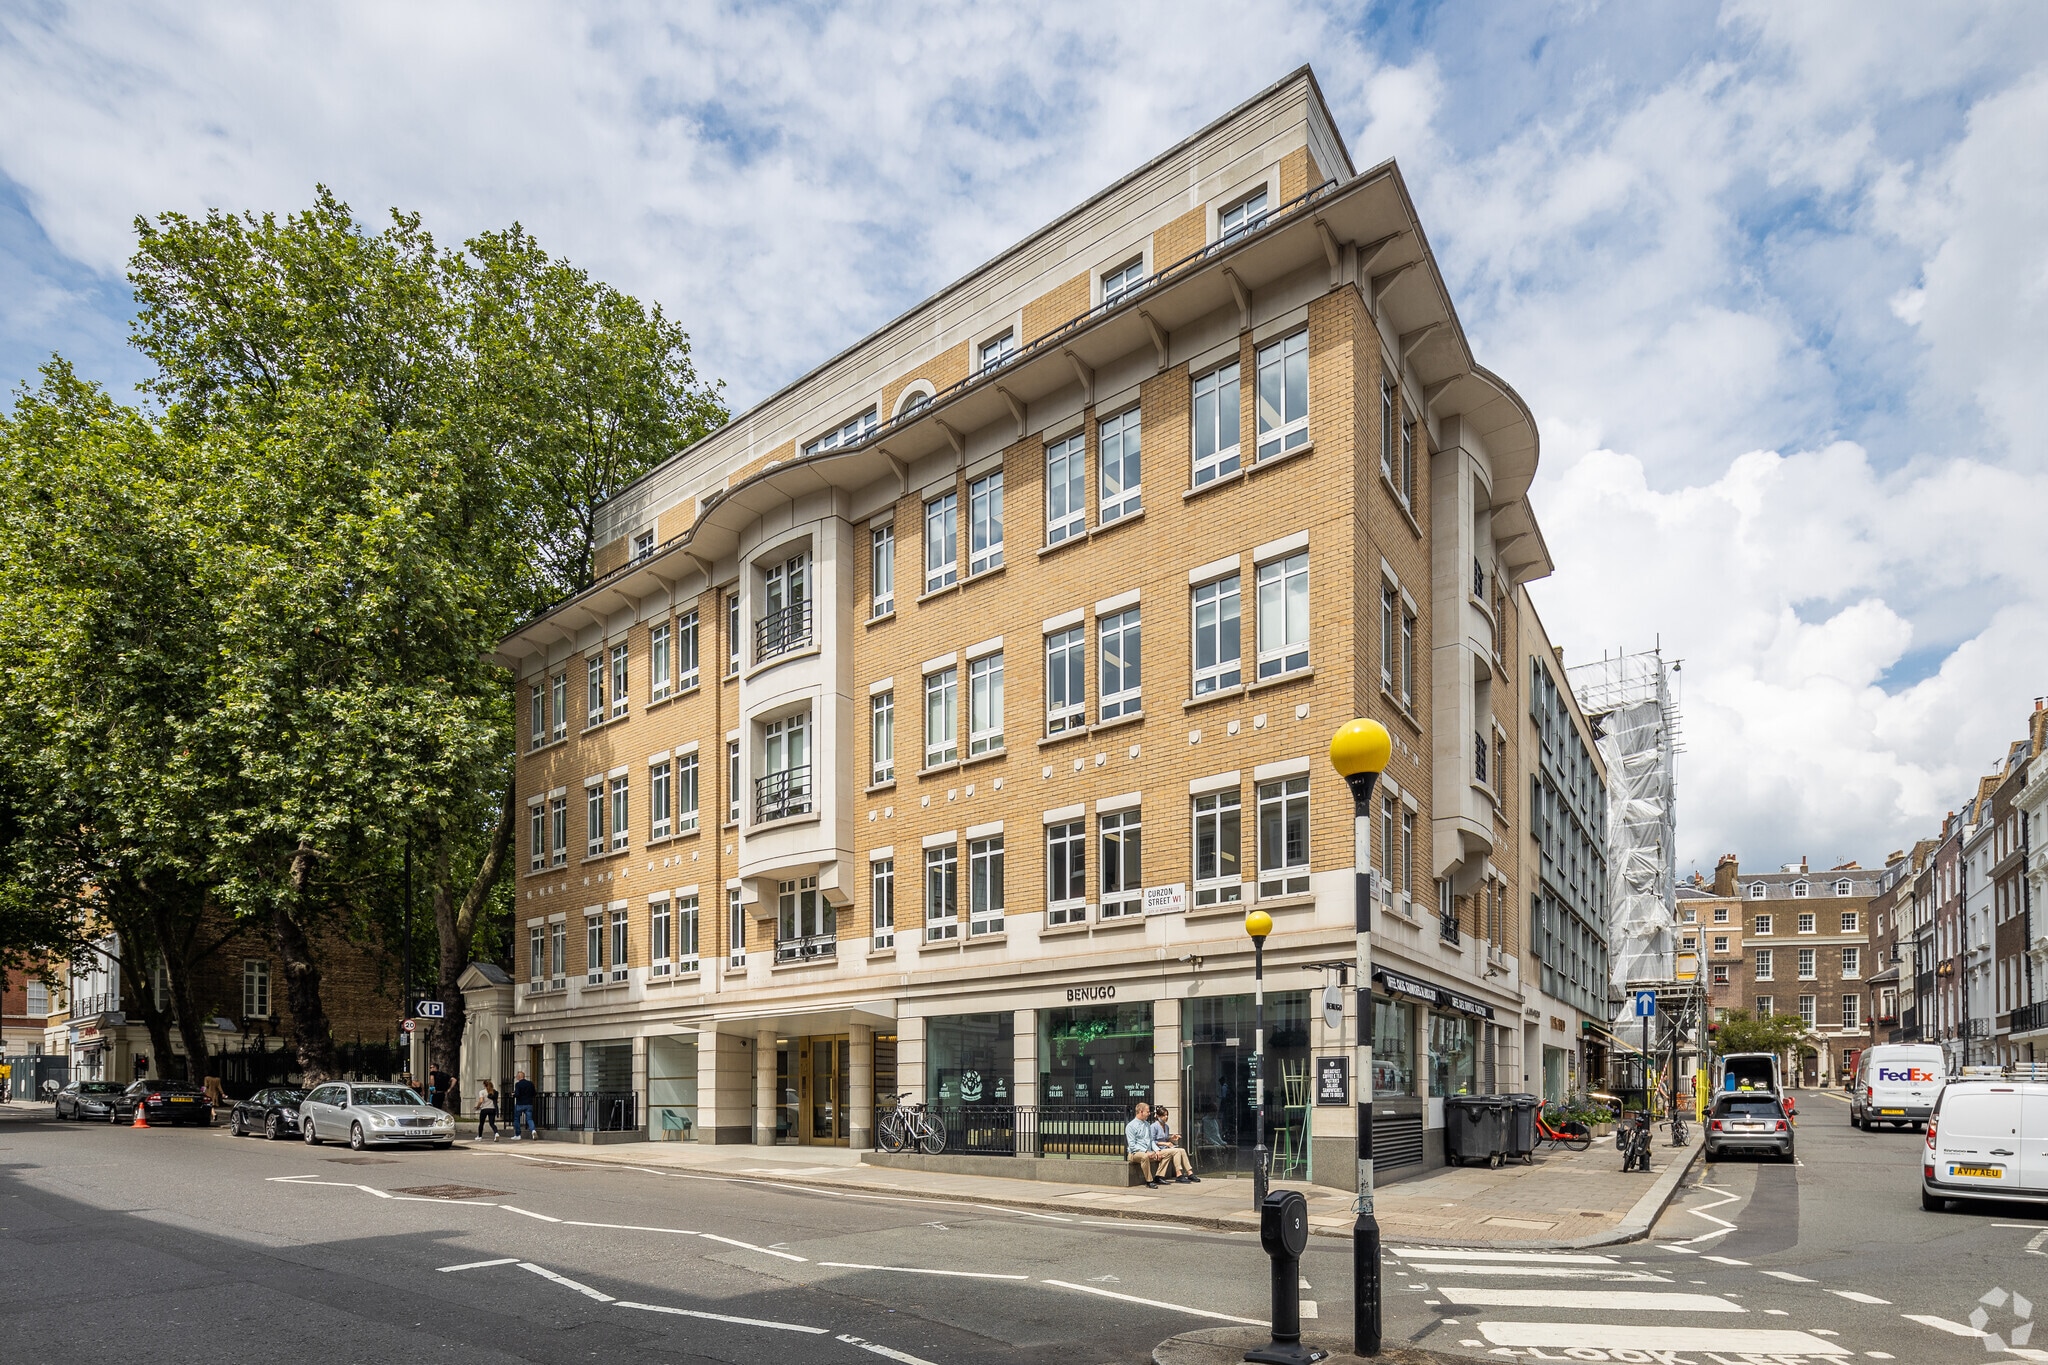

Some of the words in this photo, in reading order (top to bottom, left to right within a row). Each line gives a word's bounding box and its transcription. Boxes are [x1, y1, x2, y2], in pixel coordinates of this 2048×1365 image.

[1148, 888, 1173, 898] CURZON
[1148, 897, 1170, 907] STREET
[1172, 895, 1181, 903] W1
[1067, 986, 1115, 1001] BENUGO
[432, 1004, 440, 1014] P
[1879, 1068, 1934, 1081] FedEx
[1979, 1169, 1998, 1177] AEU
[1295, 1218, 1299, 1229] 3
[1526, 1347, 1699, 1365] LOOK
[1703, 1353, 1854, 1365] LEFT
